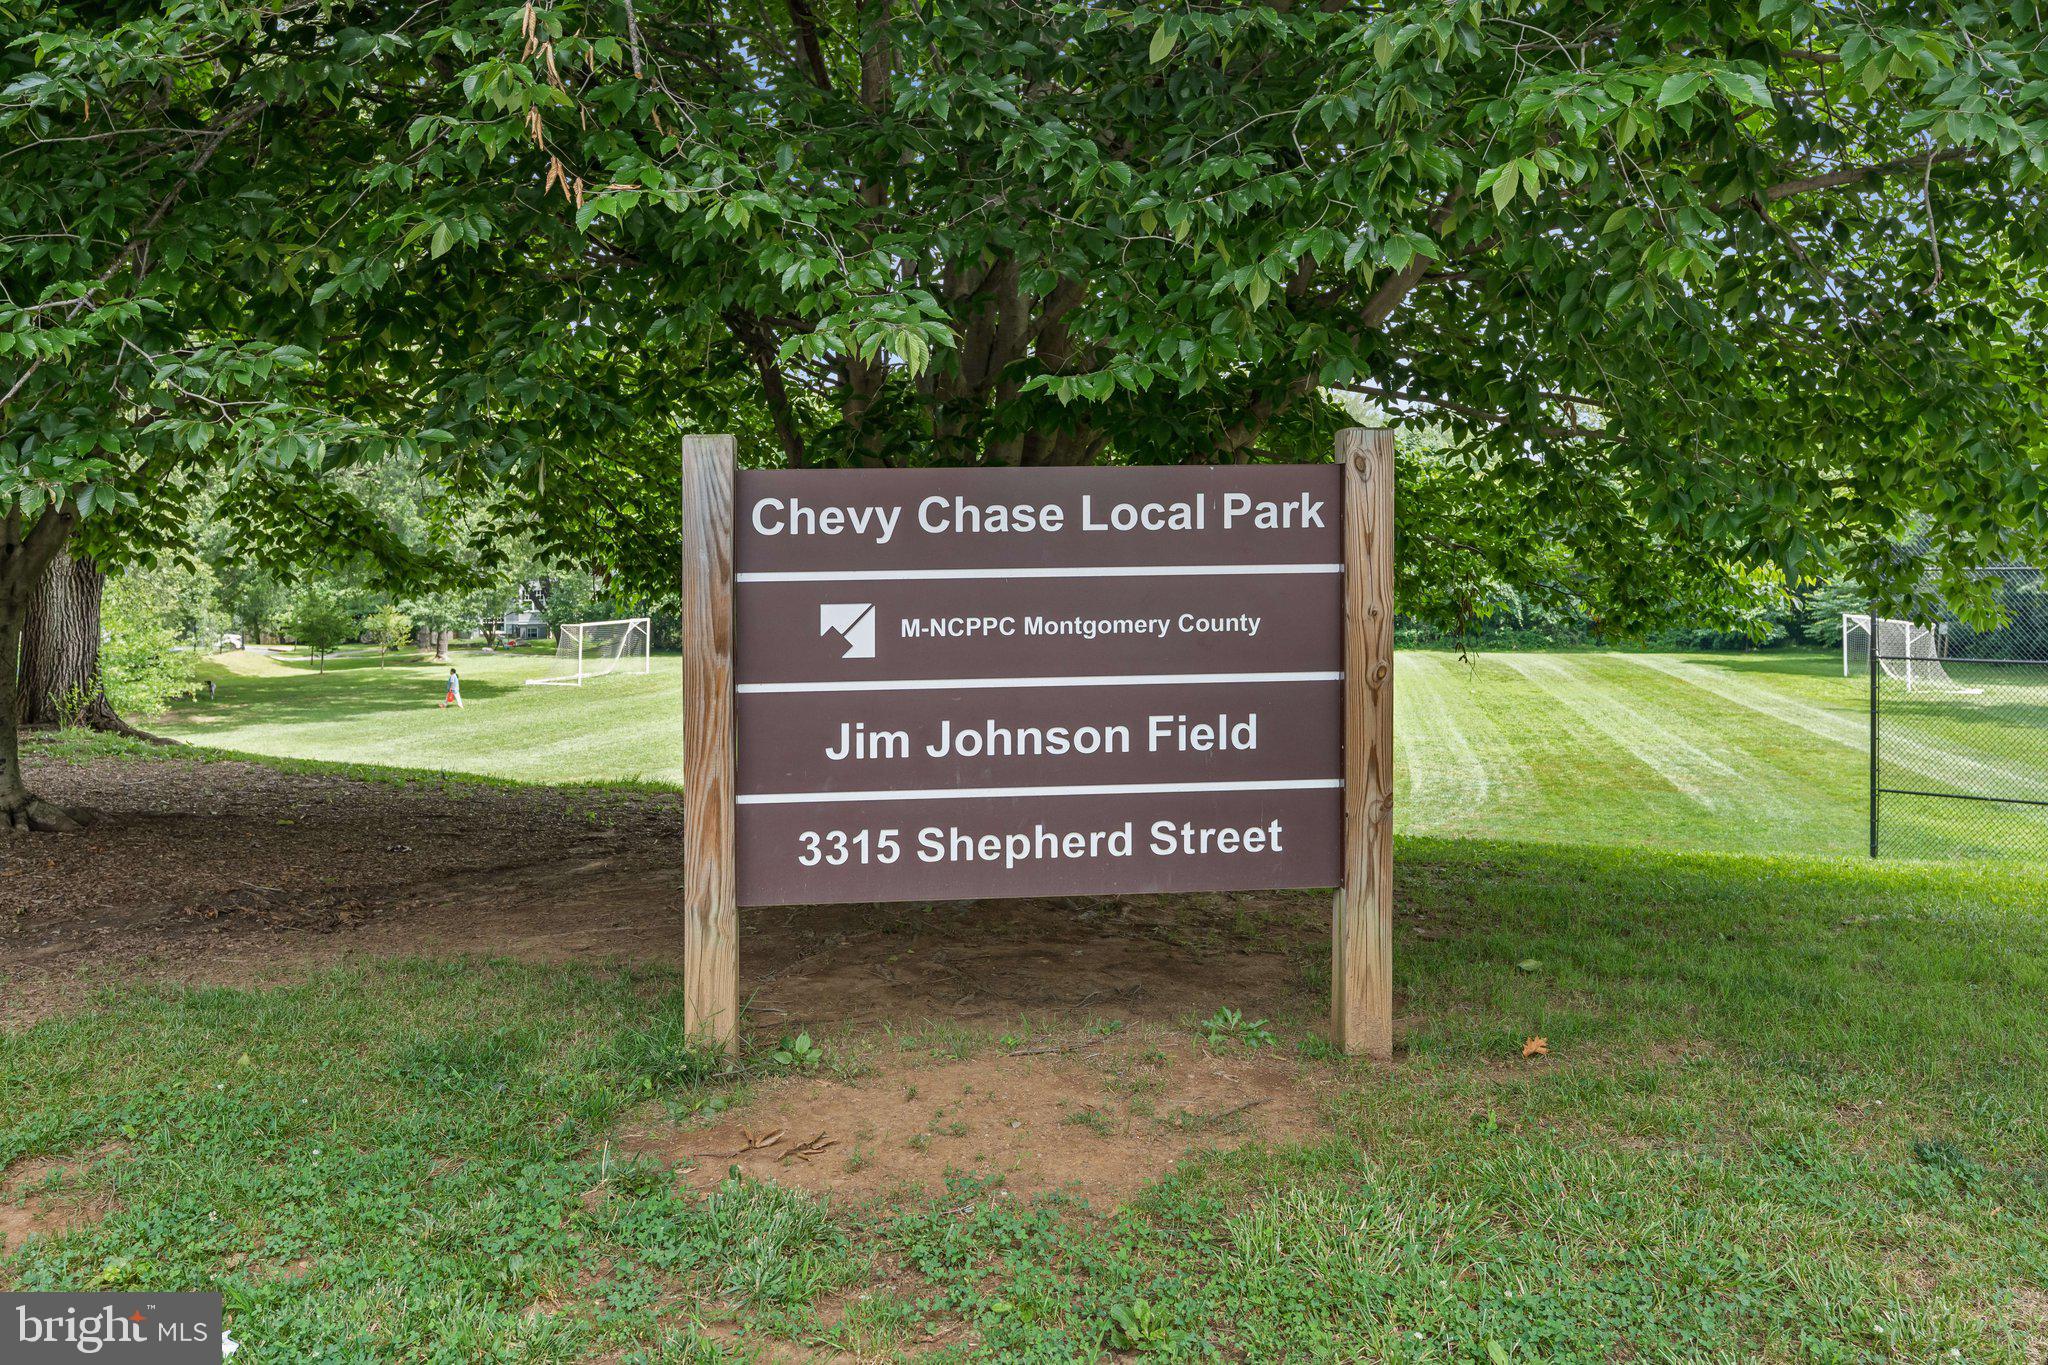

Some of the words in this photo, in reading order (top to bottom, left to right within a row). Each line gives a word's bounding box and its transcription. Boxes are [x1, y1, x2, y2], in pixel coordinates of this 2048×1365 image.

[751, 497, 902, 545] Chevy
[917, 495, 1065, 534] Chase
[1082, 494, 1206, 531] Local
[1222, 491, 1326, 530] Park
[901, 616, 1016, 638] M-NCPPC
[1024, 616, 1171, 640] Montgomery
[1178, 613, 1262, 637] County
[825, 722, 910, 761] Jim
[925, 719, 1130, 758] Johnson
[1148, 713, 1258, 752] Field
[798, 828, 901, 867] 3315
[916, 821, 1133, 869] Shepherd
[1149, 818, 1284, 856] Street
